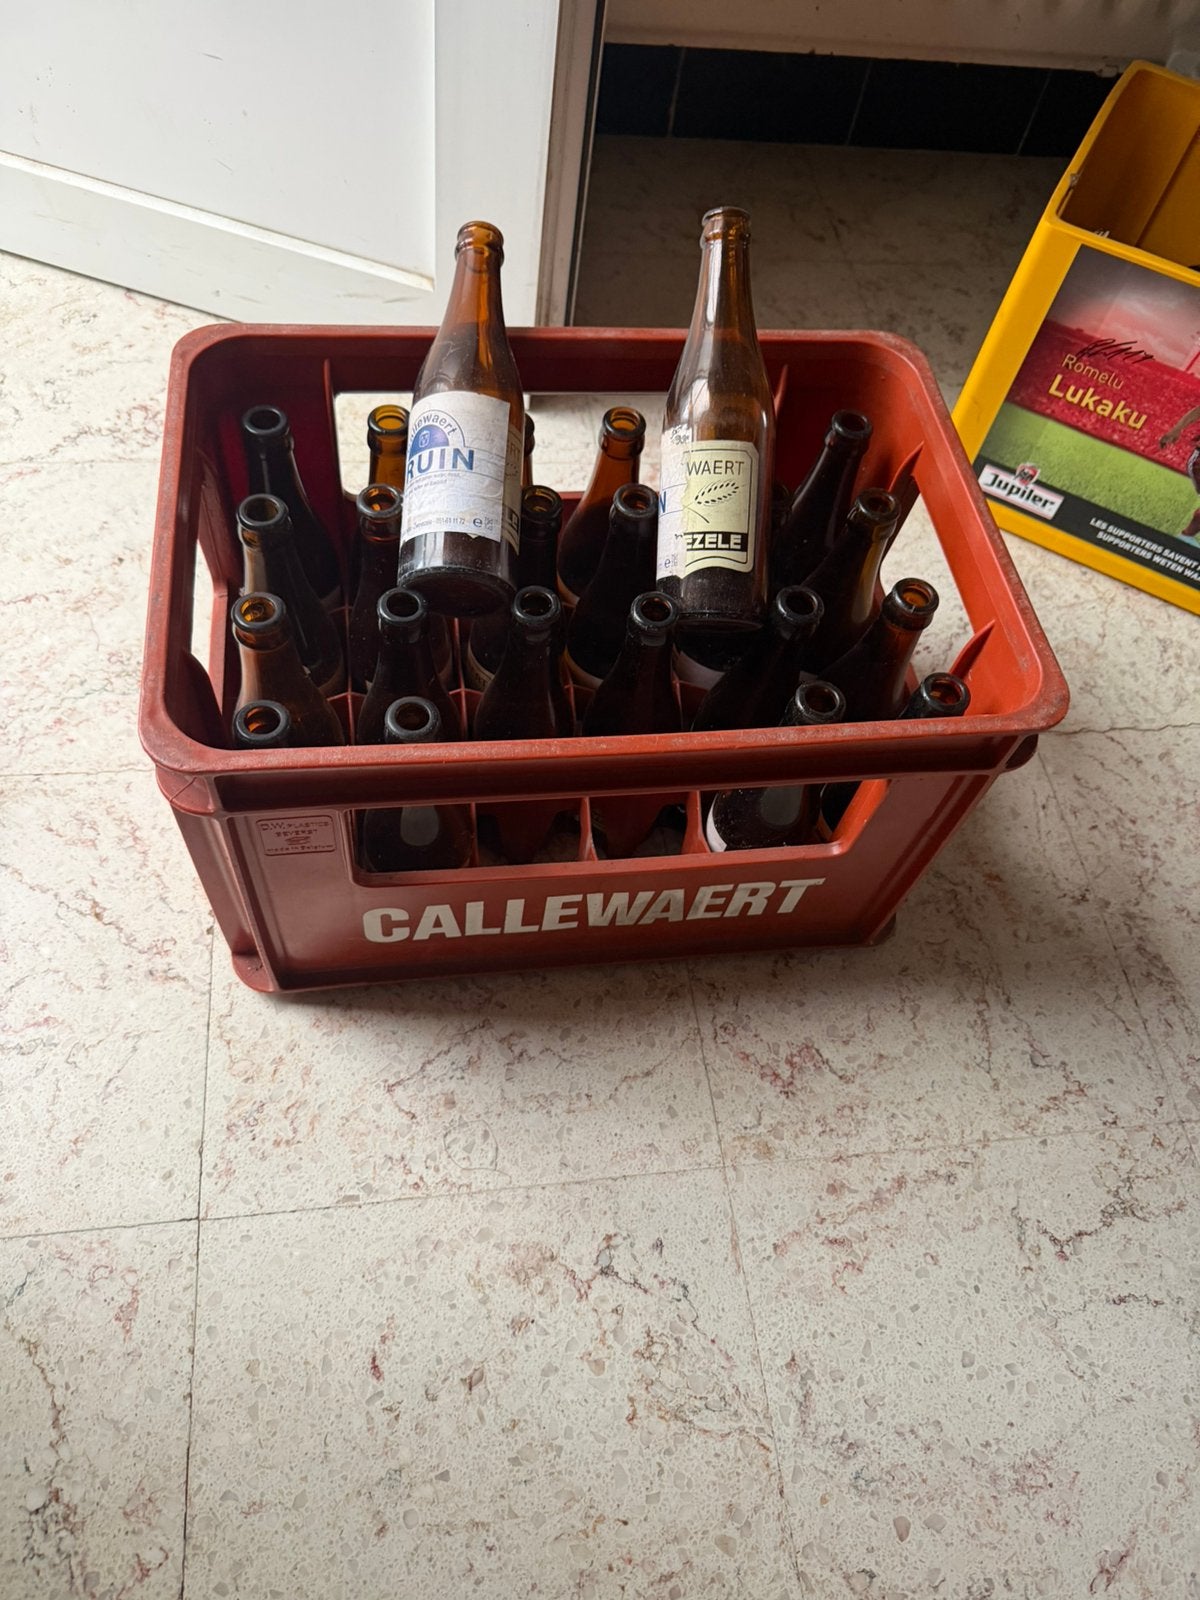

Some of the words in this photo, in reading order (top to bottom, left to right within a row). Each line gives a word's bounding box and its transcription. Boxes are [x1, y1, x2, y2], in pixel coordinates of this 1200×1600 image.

[1062, 353, 1124, 390] Romelu
[1048, 374, 1147, 429] Lukaku
[983, 473, 1055, 508] Jupiler
[1090, 517, 1108, 530] LES
[1107, 524, 1164, 554] SUPPORTERS
[1162, 548, 1199, 569] SAVENT
[1096, 531, 1153, 560] SUPPORTERS
[1152, 554, 1184, 574] WETEN
[362, 877, 827, 943] CALLEWAERT
